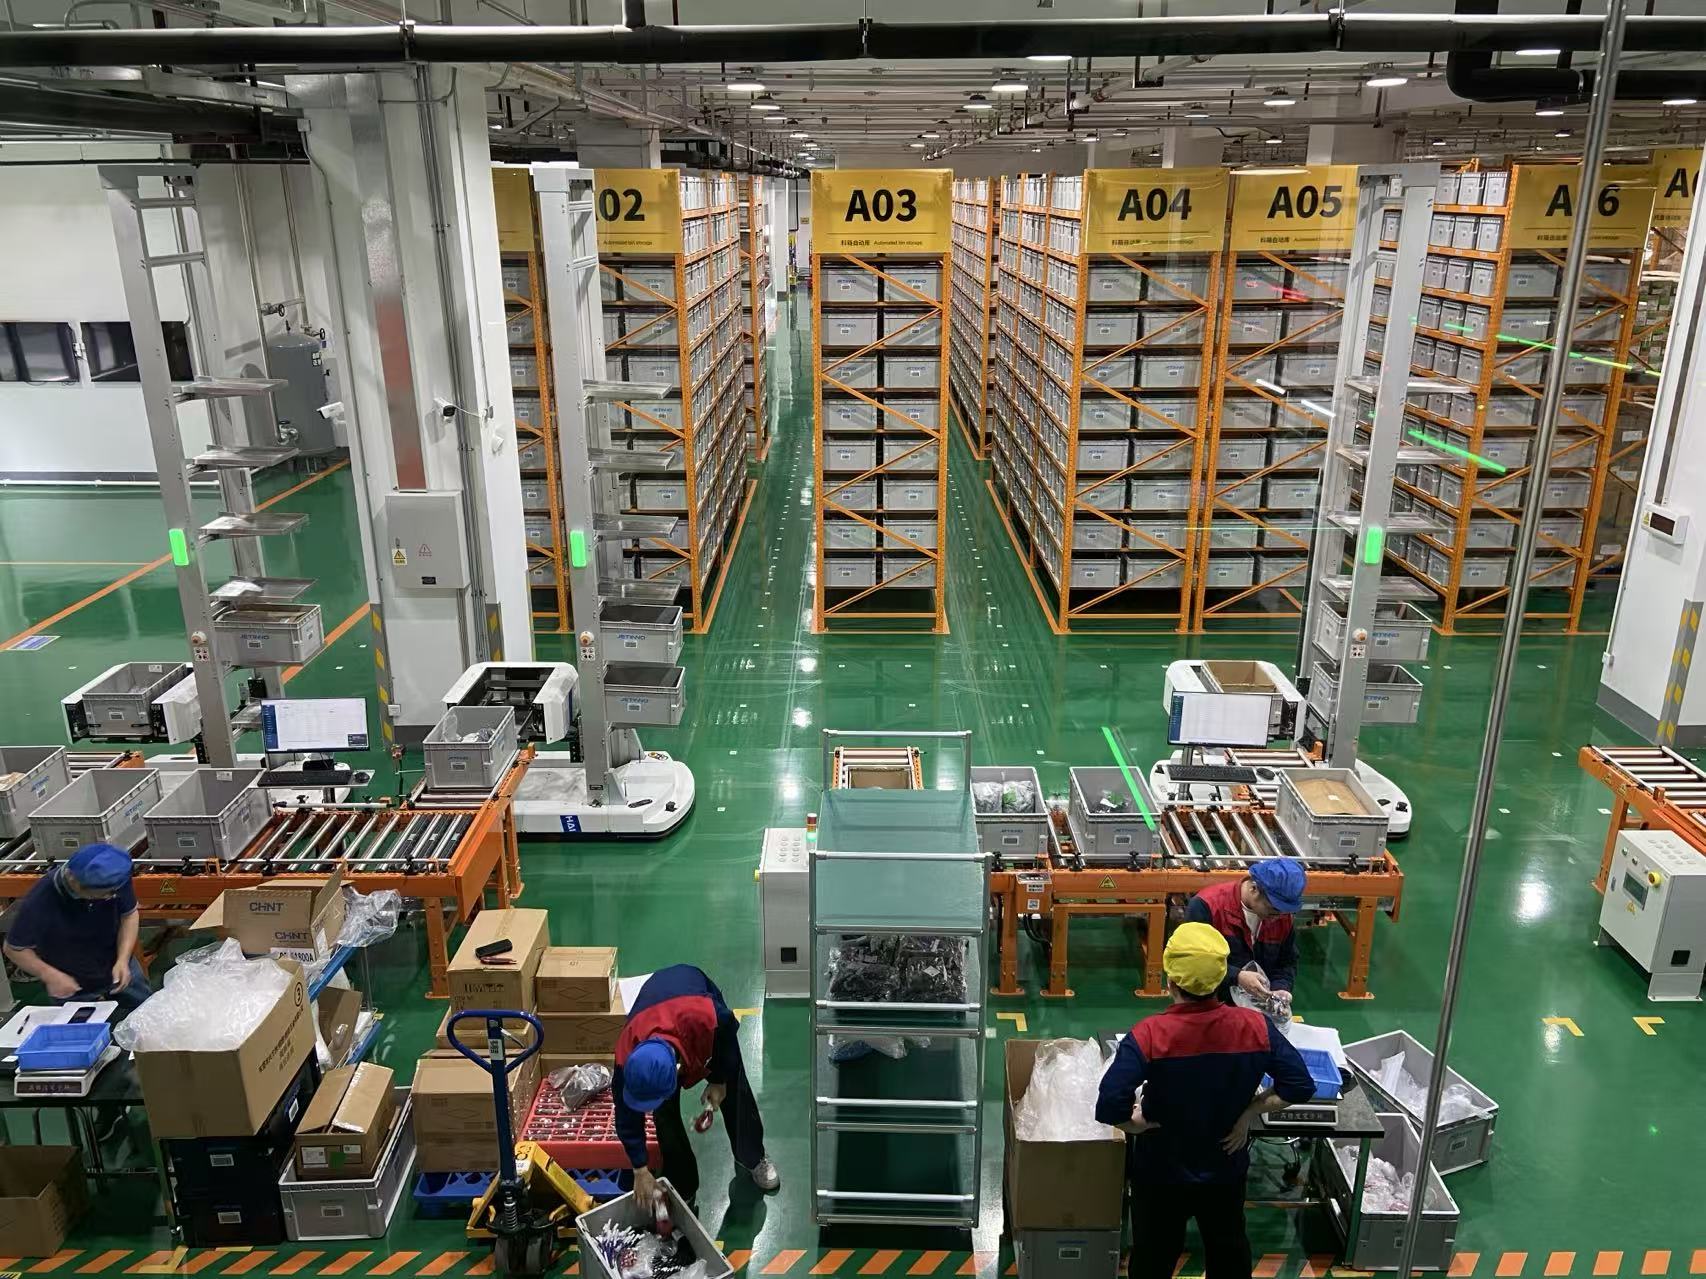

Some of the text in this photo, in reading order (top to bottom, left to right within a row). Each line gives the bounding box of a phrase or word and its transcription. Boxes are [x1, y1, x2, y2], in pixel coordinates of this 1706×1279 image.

[596, 188, 645, 222] 02
[845, 189, 917, 222] A03
[1118, 187, 1192, 221] A04
[1267, 185, 1343, 219] A05
[1545, 183, 1620, 217] A6
[249, 902, 284, 912] CHNT
[275, 932, 309, 940] CHNT
